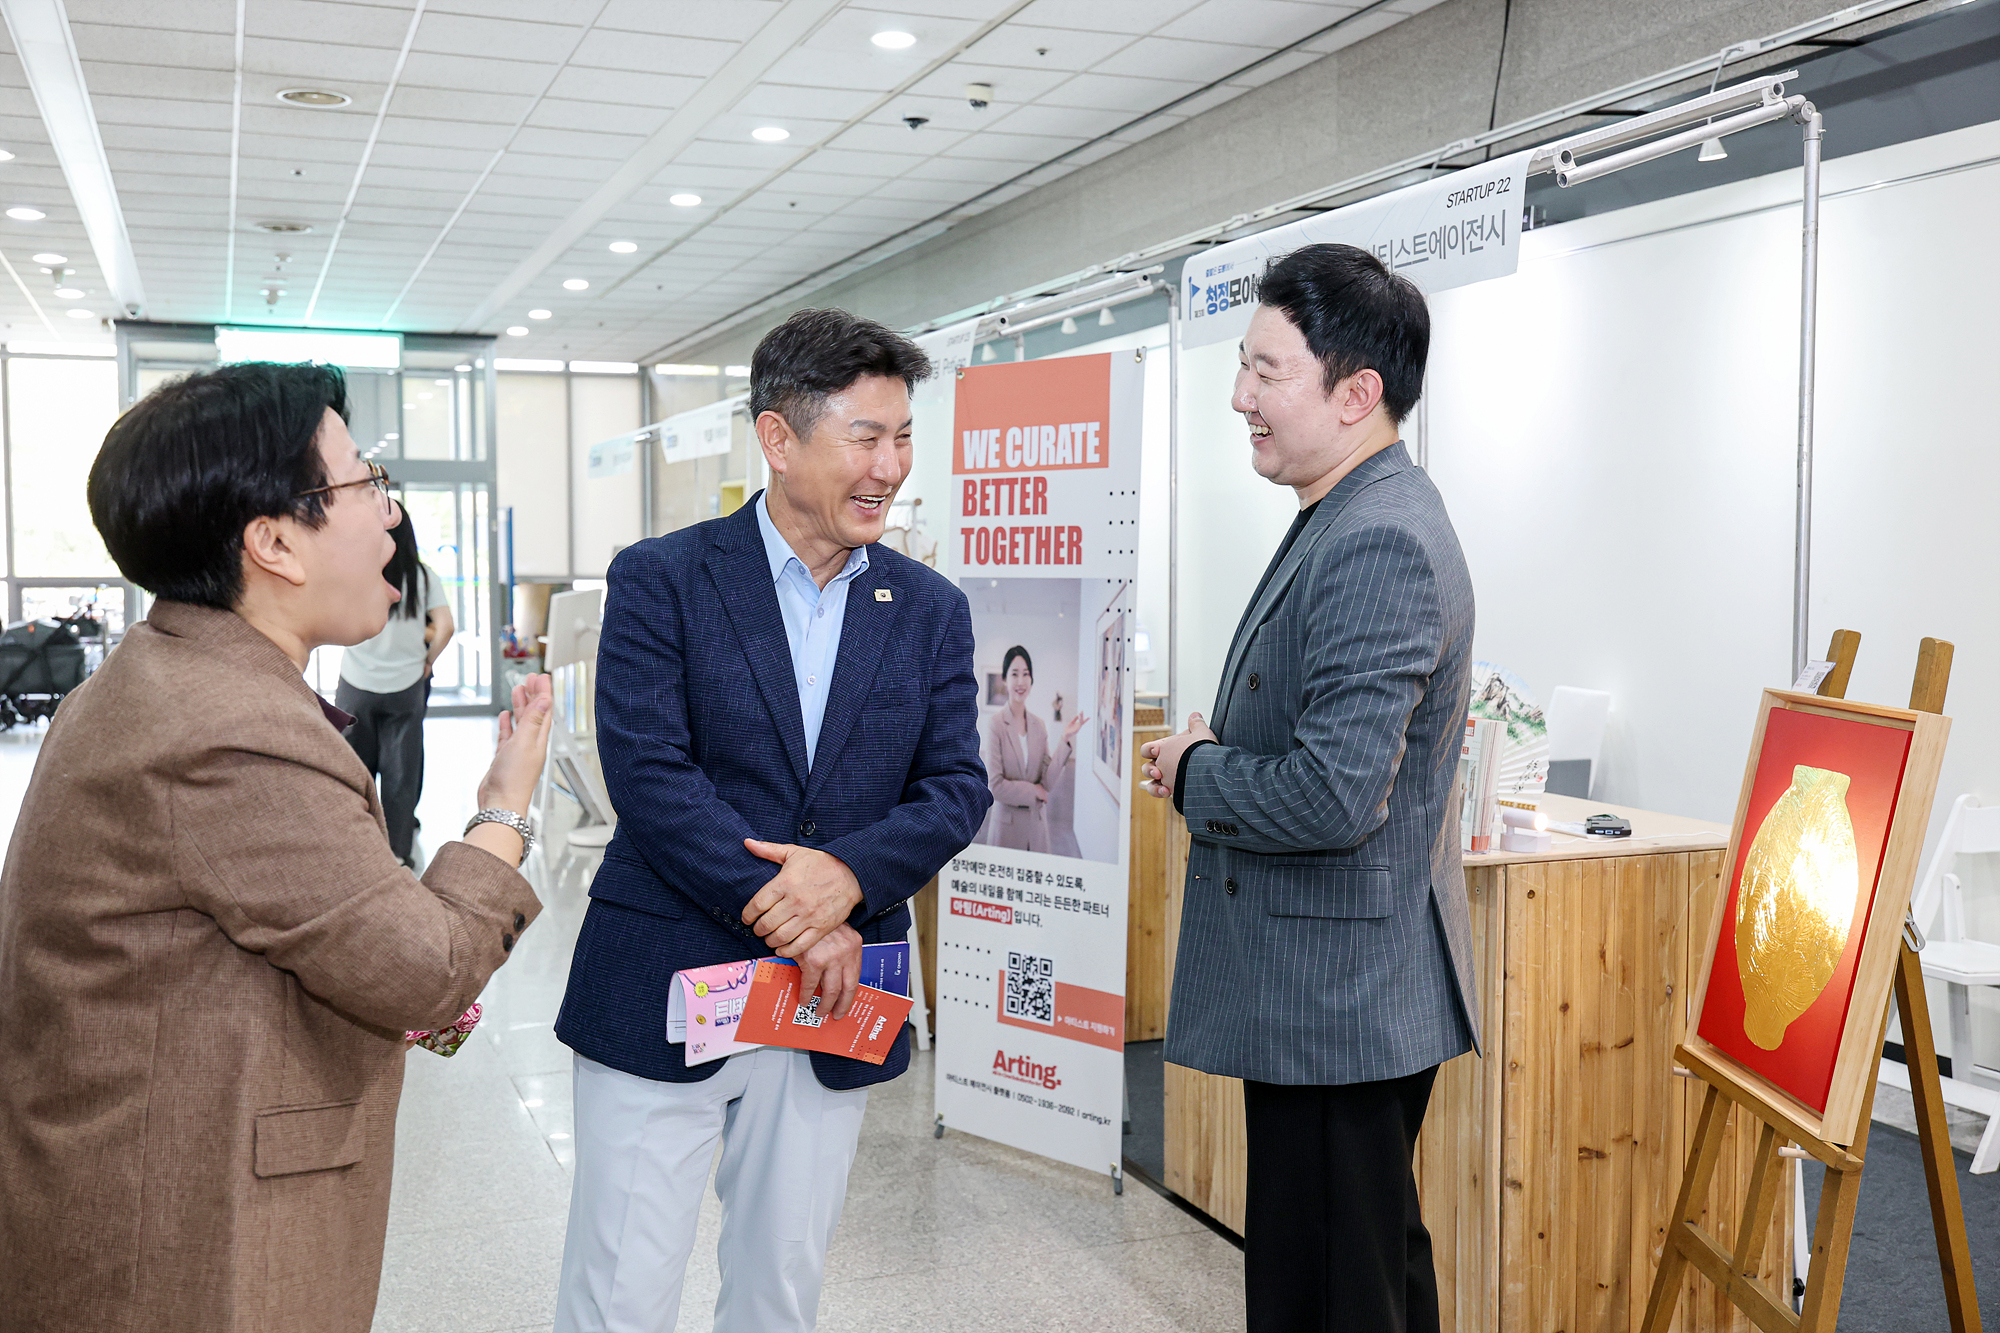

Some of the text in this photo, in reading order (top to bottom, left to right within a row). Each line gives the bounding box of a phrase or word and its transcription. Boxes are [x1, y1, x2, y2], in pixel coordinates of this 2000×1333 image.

[1446, 177, 1511, 209] STARTUP 22
[963, 421, 1100, 469] WE CURATE
[962, 476, 1048, 516] BETTER
[961, 525, 1083, 565] TOGETHER
[989, 864, 1014, 880] 온전히
[1016, 868, 1043, 885] 집중할
[1045, 873, 1054, 886] 수
[1056, 874, 1086, 892] 있도록,
[951, 879, 1110, 918] 예술의 내일을 함께 그리는 든든한 파트너
[1014, 910, 1043, 927] 입니다.
[993, 1049, 1062, 1090] Arting.
